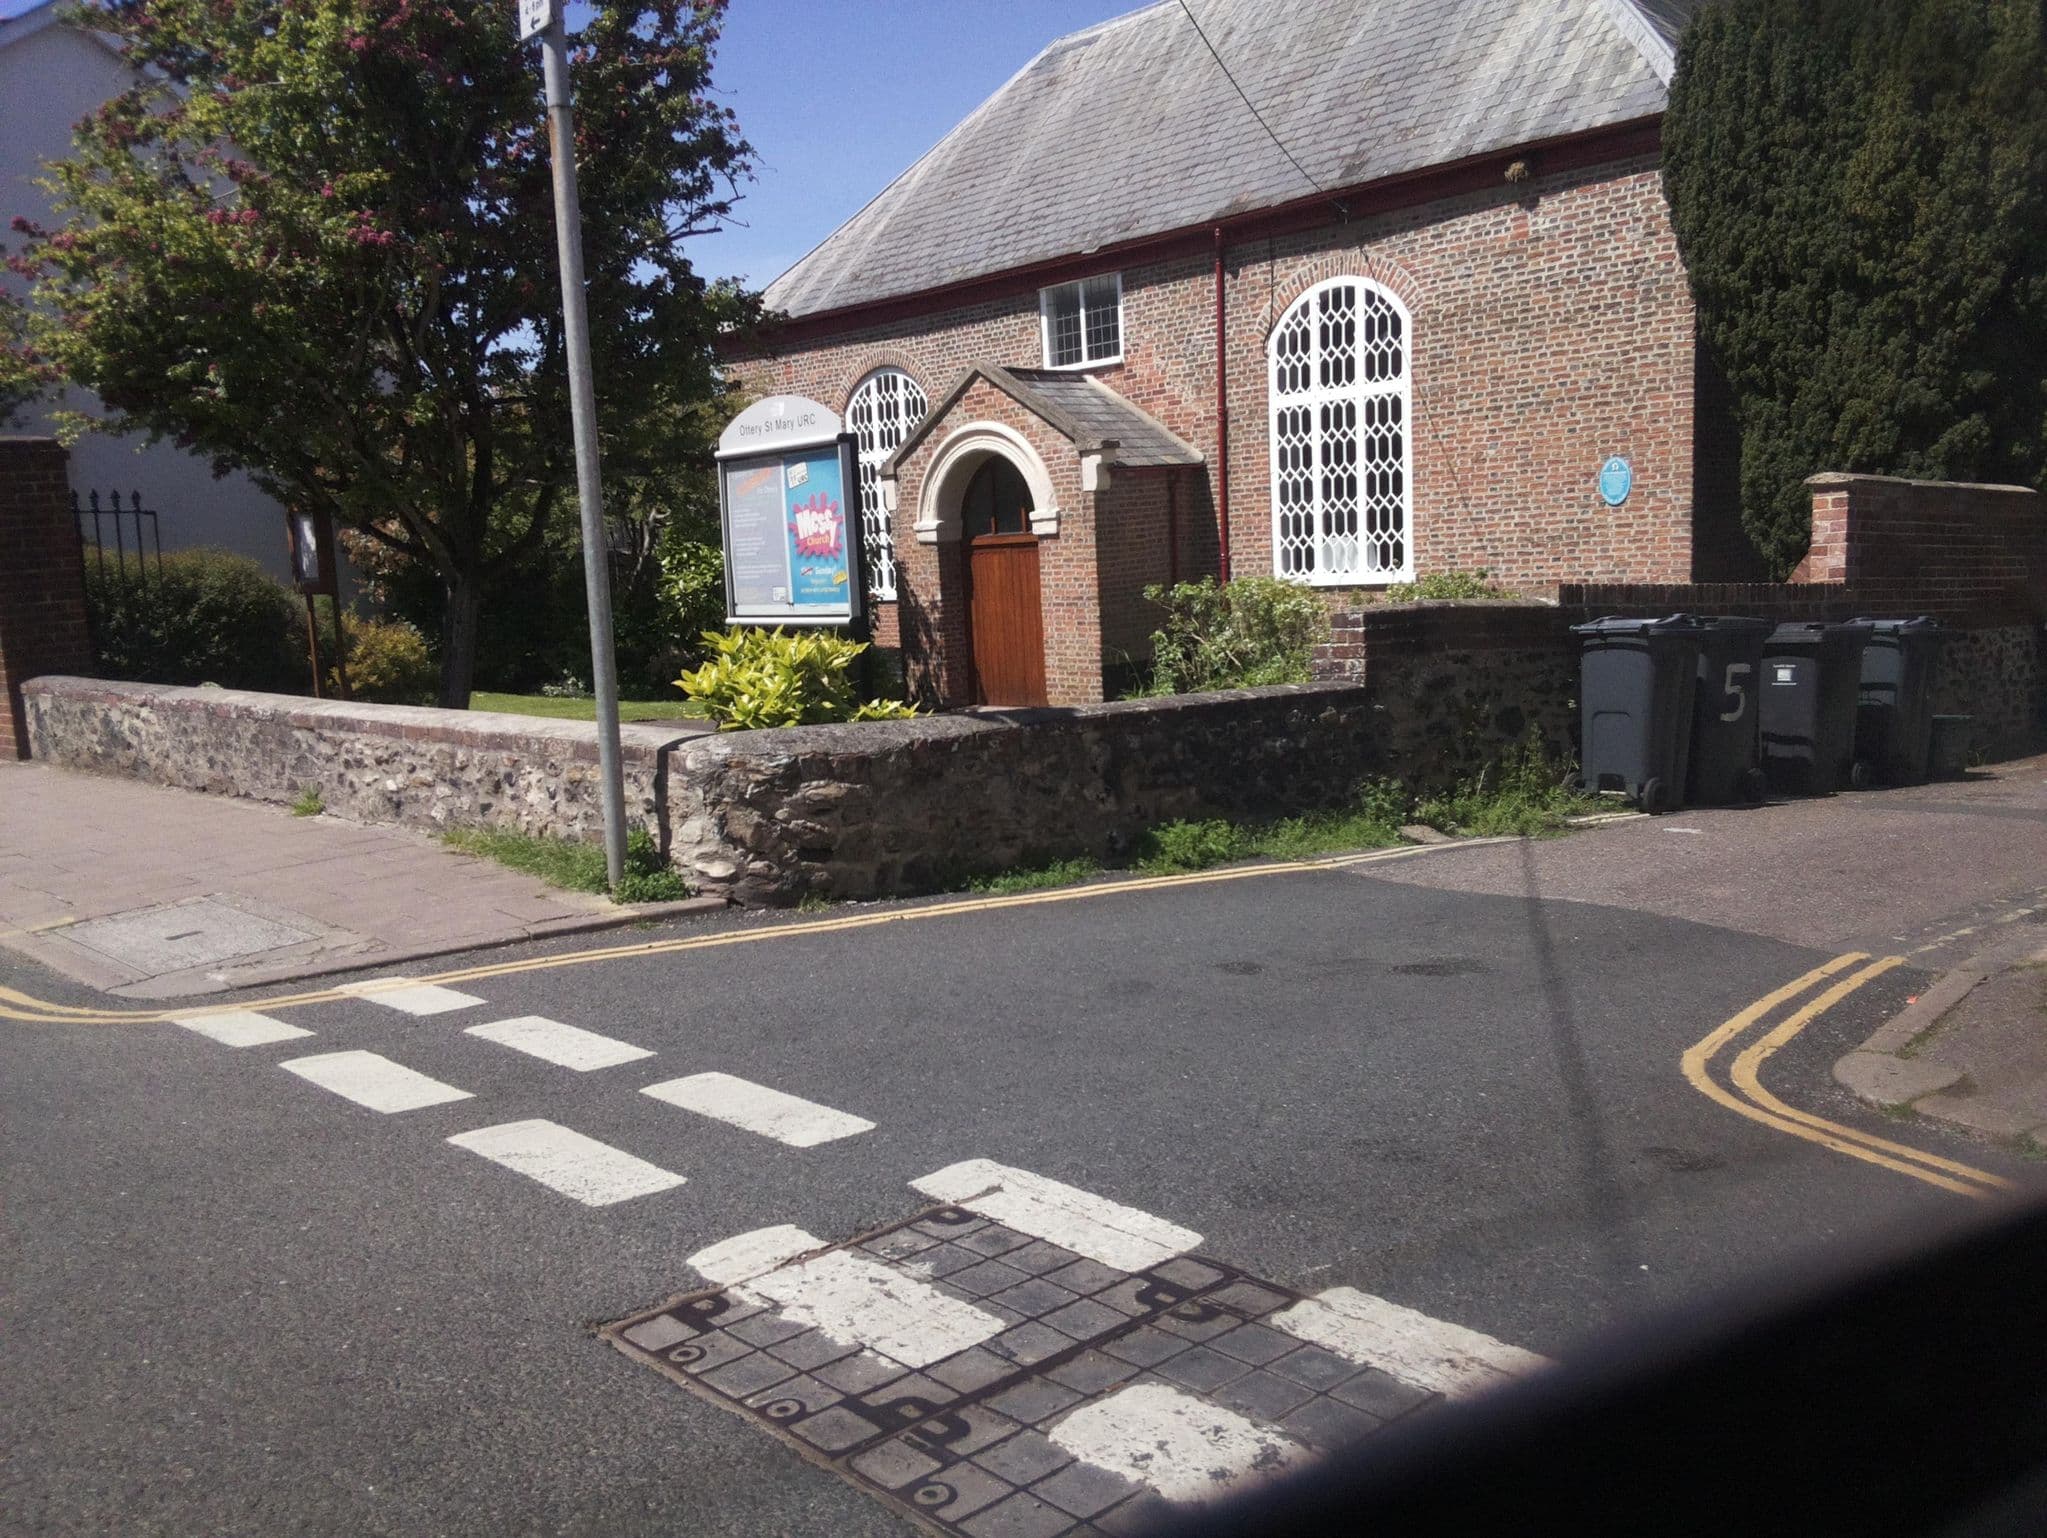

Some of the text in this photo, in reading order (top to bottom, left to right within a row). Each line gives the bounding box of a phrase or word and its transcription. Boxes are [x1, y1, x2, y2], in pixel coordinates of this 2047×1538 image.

[739, 413, 816, 436] Ottery St Mary URC
[807, 535, 830, 546] Church
[1721, 664, 1750, 721] 5
